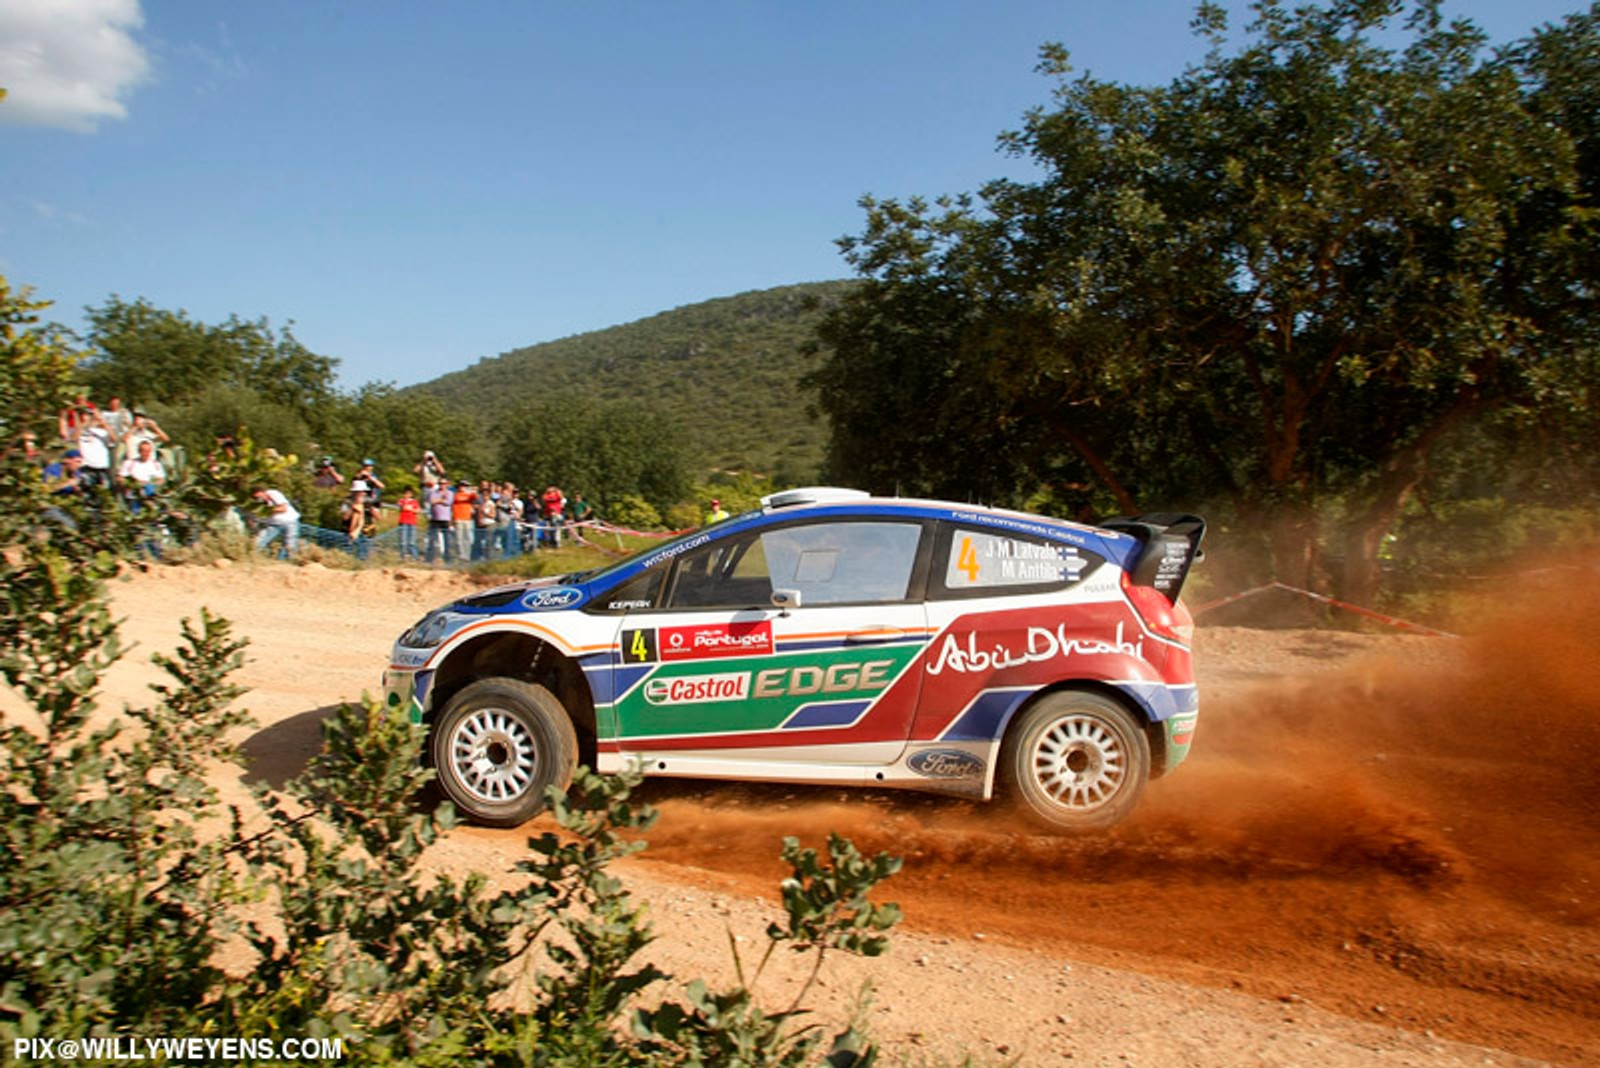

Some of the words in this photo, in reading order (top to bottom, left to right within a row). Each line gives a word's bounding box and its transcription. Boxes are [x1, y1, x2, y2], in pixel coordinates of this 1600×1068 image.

[952, 511, 977, 520] Ford
[978, 515, 1046, 533] recommends
[1048, 529, 1085, 543] Castrol
[642, 534, 711, 568] wrcford.com
[957, 536, 980, 582] 4
[985, 540, 994, 558] J
[998, 541, 1010, 558] M
[1002, 560, 1016, 578] M
[531, 591, 572, 608] Ford
[631, 629, 648, 662] 4
[694, 632, 769, 648] Portugal
[926, 630, 1027, 675] Abu
[1027, 621, 1145, 662] Dhabi
[670, 675, 743, 700] Castrol
[753, 659, 896, 698] EDGE
[921, 754, 973, 774] Ford
